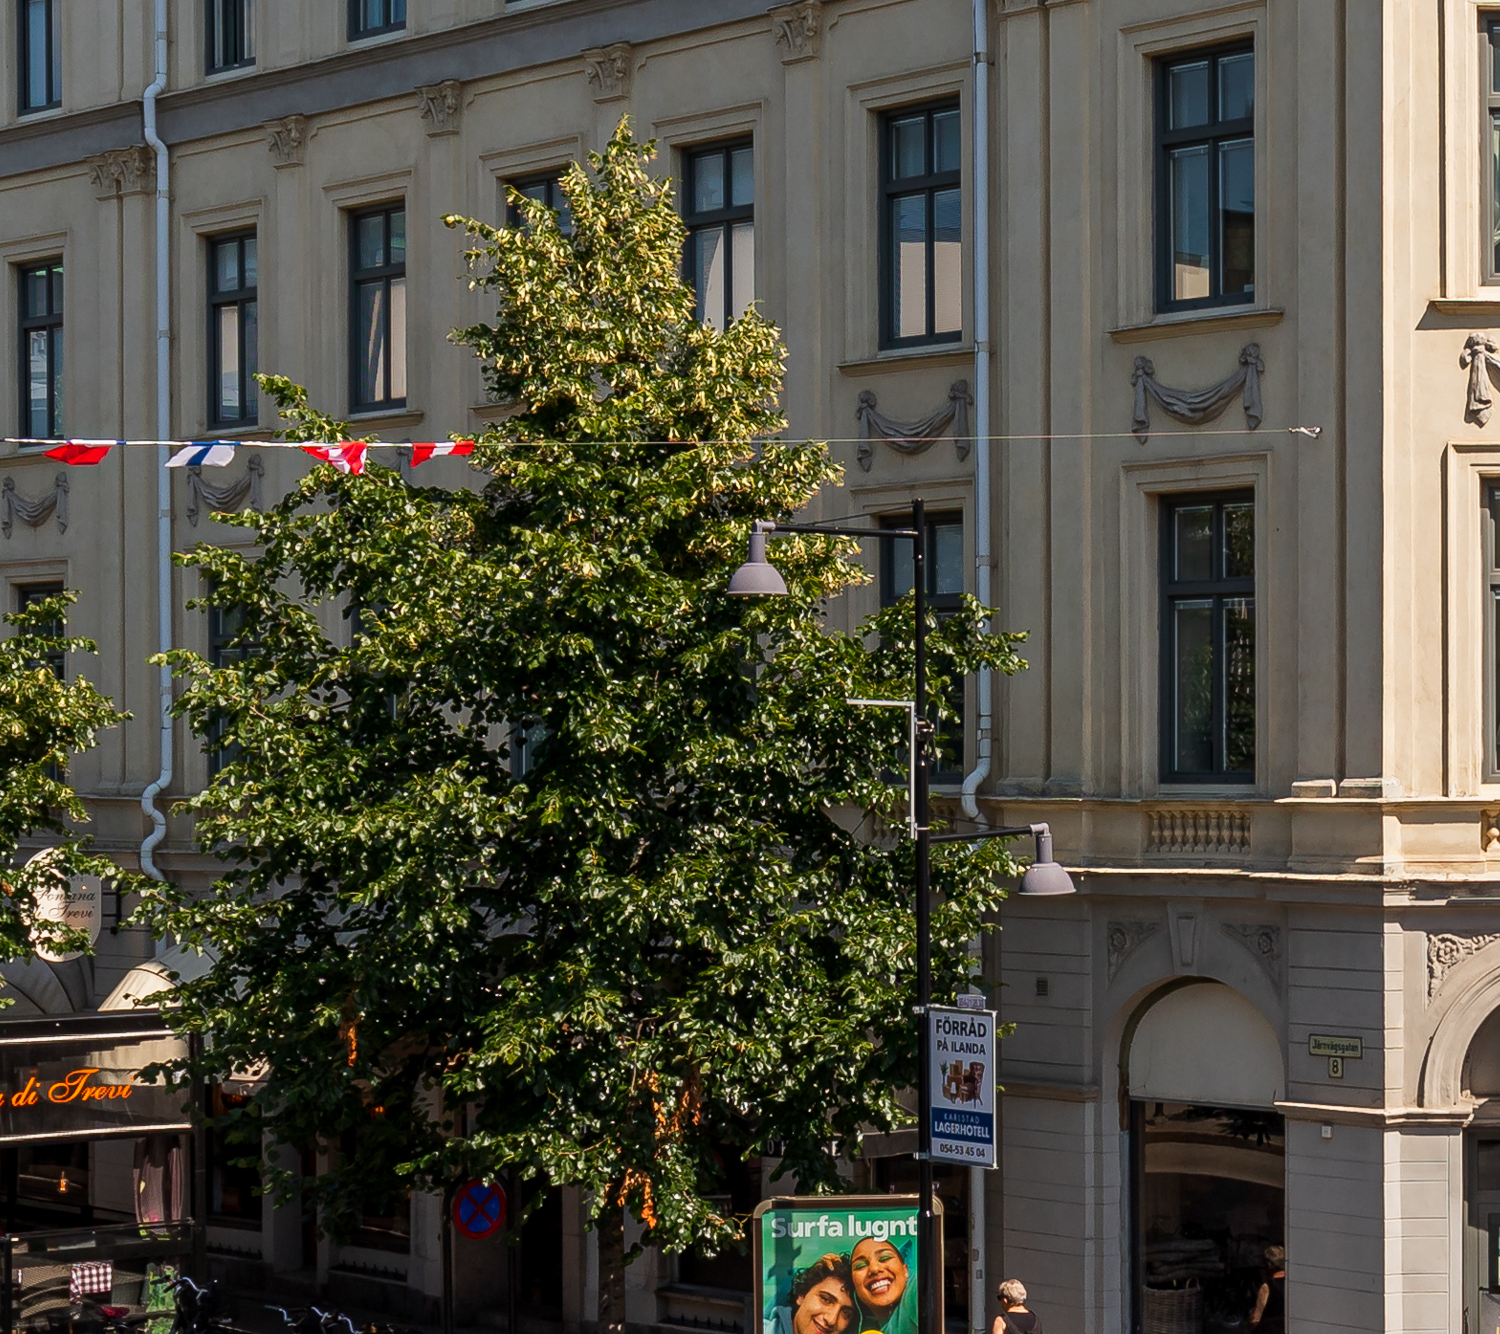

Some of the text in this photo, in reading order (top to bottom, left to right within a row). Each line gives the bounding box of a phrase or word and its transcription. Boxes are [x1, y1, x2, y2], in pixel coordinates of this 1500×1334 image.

[48, 901, 95, 919] Trevi
[935, 1016, 987, 1038] FÖRRÅD
[936, 1037, 986, 1055] PÅ ILANDA
[1332, 1059, 1339, 1074] 8
[11, 1076, 41, 1107] di
[48, 1068, 135, 1103] Trevi
[943, 1113, 980, 1124] KARLSTAD
[934, 1121, 990, 1138] LAGERHOTELL
[939, 1143, 986, 1158] 054-53 45 04
[771, 1214, 918, 1242] Surfa lugnt
